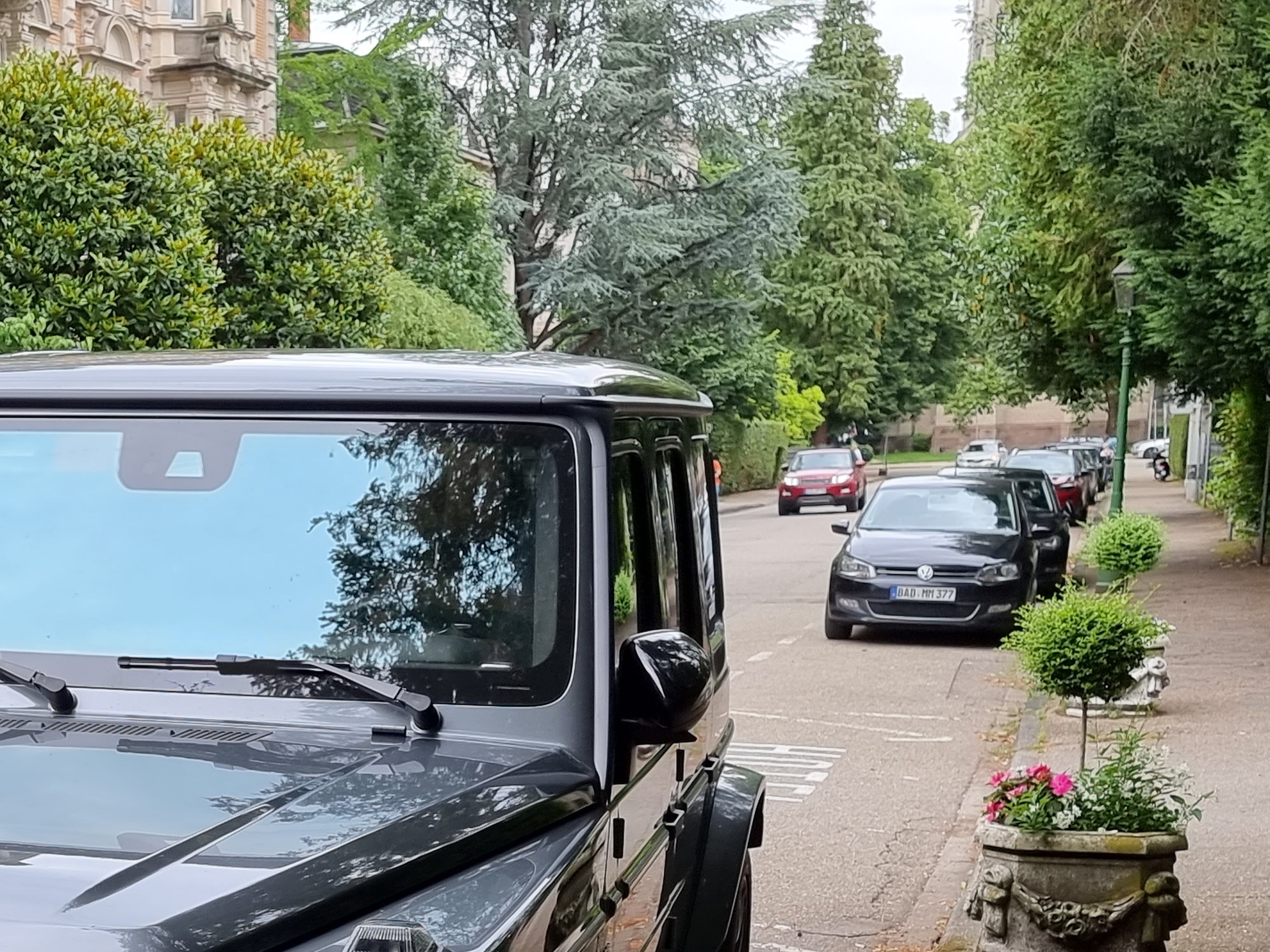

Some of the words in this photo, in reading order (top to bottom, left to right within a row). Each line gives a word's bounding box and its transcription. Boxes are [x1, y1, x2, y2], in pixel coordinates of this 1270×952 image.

[898, 588, 916, 598] BAD
[922, 589, 934, 598] MM
[936, 590, 954, 599] 377
